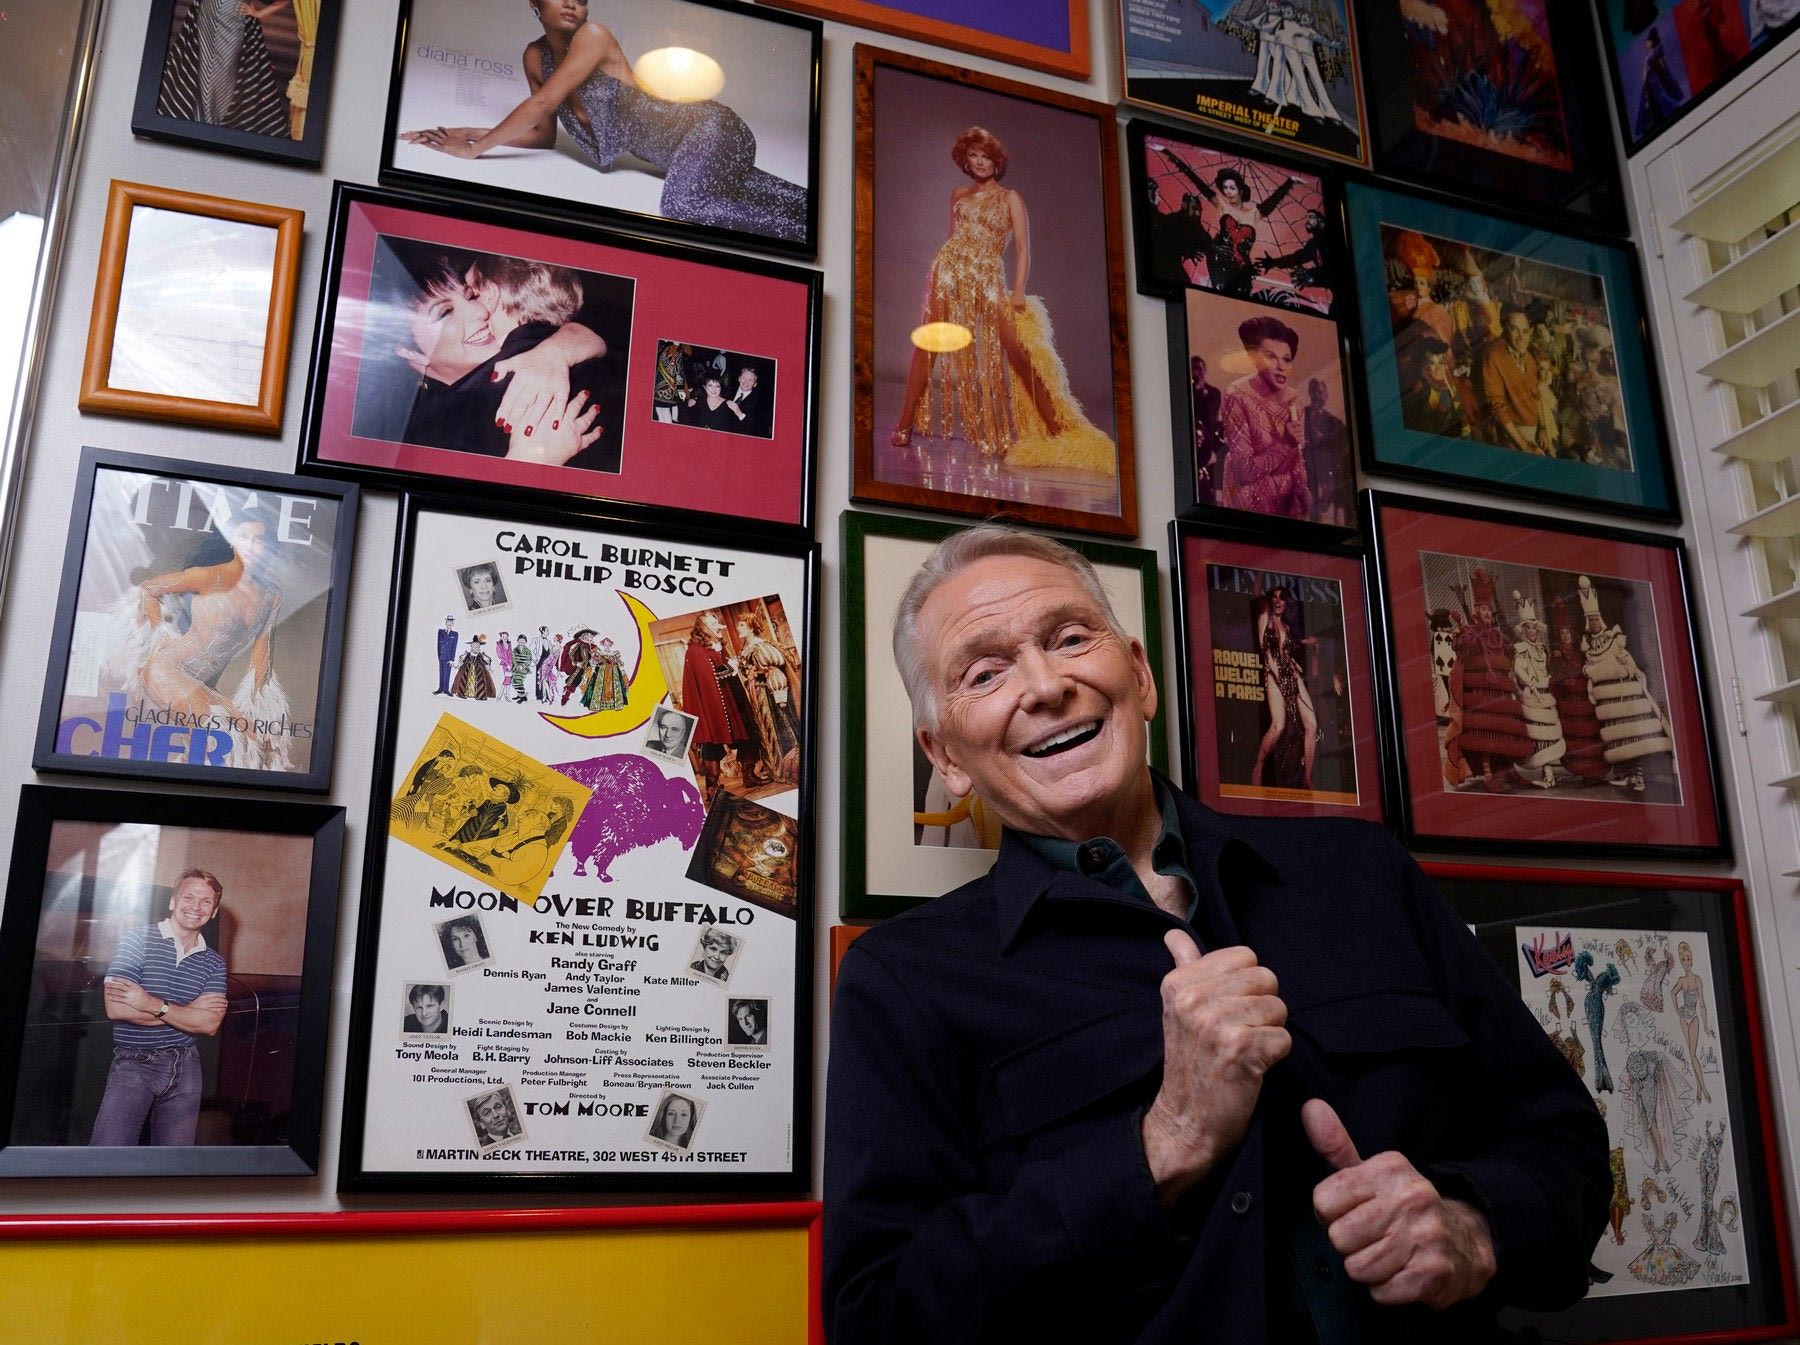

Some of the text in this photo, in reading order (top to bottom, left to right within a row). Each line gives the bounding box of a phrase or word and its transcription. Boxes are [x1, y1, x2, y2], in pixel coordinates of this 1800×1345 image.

[417, 44, 467, 67] diana
[475, 58, 513, 76] ross
[1196, 94, 1300, 132] IMPERIAL THEATER
[496, 531, 735, 577] CAROL BURNETT
[515, 556, 714, 597] PHILIP BOSCO
[1214, 649, 1264, 669] RAQUEL
[1214, 666, 1260, 685] WELCH
[1228, 683, 1265, 702] PARIS
[175, 712, 220, 734] RAGS
[226, 716, 249, 733] TO
[429, 885, 755, 925] MOON OVER BUFFALO
[555, 921, 637, 935] The New Comedy by
[529, 930, 659, 951] KEN LUDWIG
[551, 957, 637, 973] Randy Graff
[483, 968, 547, 981] Dennis Ryan
[565, 972, 625, 985] Andy Taylor
[643, 975, 700, 987] Kate Miller
[544, 982, 641, 997] James Valentine
[546, 1002, 637, 1017] Jane Connell
[502, 1019, 525, 1027] Design
[598, 1023, 620, 1031] Design
[656, 1025, 681, 1033] Lighting
[452, 1027, 552, 1040] Heidi Landesman
[566, 1030, 632, 1043] Bob Mackie
[645, 1033, 723, 1047] Ken Billington
[477, 1044, 494, 1052] Fight
[495, 1045, 520, 1053] Staging
[594, 1048, 619, 1056] Casting
[696, 1051, 730, 1059] Production
[395, 1049, 459, 1062] Tony Meola
[498, 1052, 531, 1065] Barry
[544, 1054, 674, 1067] Johnson-Liff Associates
[687, 1058, 771, 1070] Steven Beckler
[412, 1074, 505, 1085] 101 Productions, Ltd.
[521, 1078, 588, 1088] Peter Fulbright
[706, 1082, 726, 1090] Jack
[524, 1100, 649, 1117] TOM MOORE
[426, 1149, 479, 1160] MARTIN
[482, 1149, 521, 1161] BECK
[525, 1150, 590, 1164] THEATRE,
[593, 1151, 616, 1162] 302
[620, 1151, 658, 1162] WEST
[697, 1152, 747, 1163] STREET
